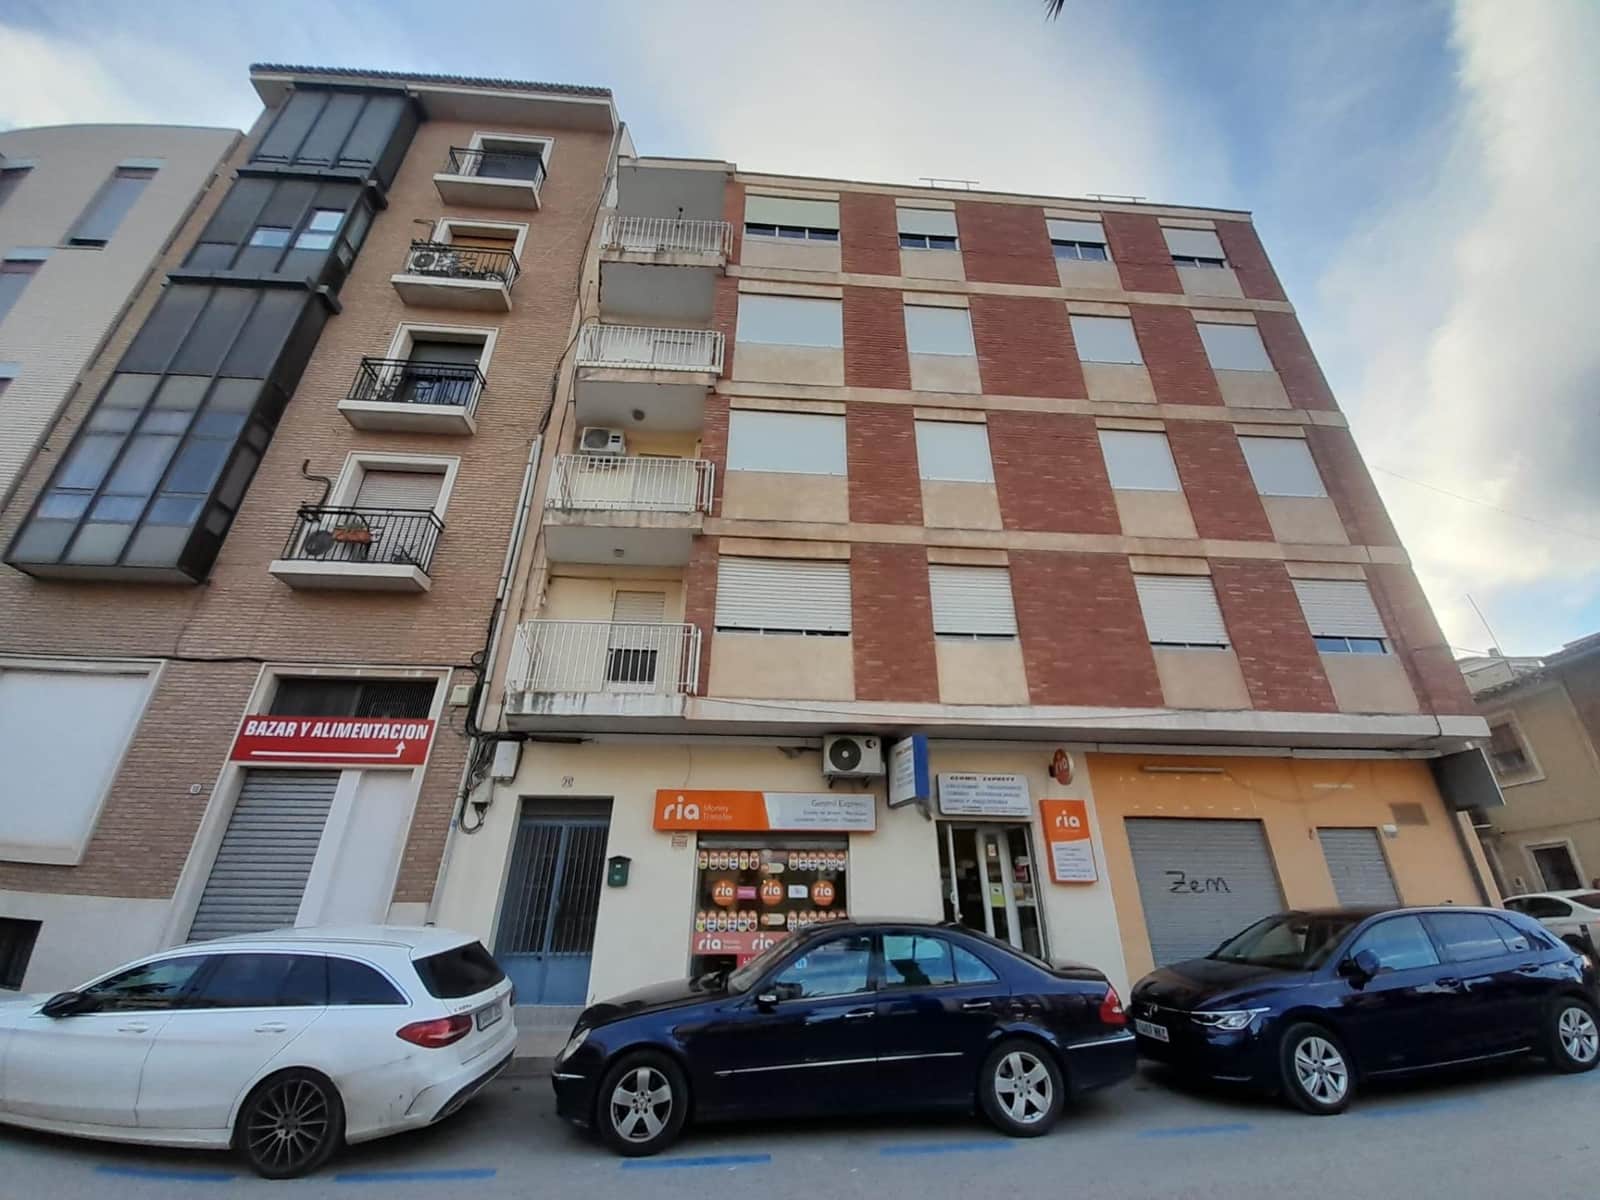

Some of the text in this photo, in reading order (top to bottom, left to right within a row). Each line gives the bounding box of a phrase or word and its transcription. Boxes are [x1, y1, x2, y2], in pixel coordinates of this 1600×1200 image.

[244, 720, 429, 740] BAZAR Y ALIMENTACION
[664, 795, 699, 820] ria
[1055, 809, 1081, 828] ria
[715, 882, 733, 896] ria
[763, 882, 780, 896] ria
[814, 883, 832, 896] ria
[698, 933, 721, 950] ria
